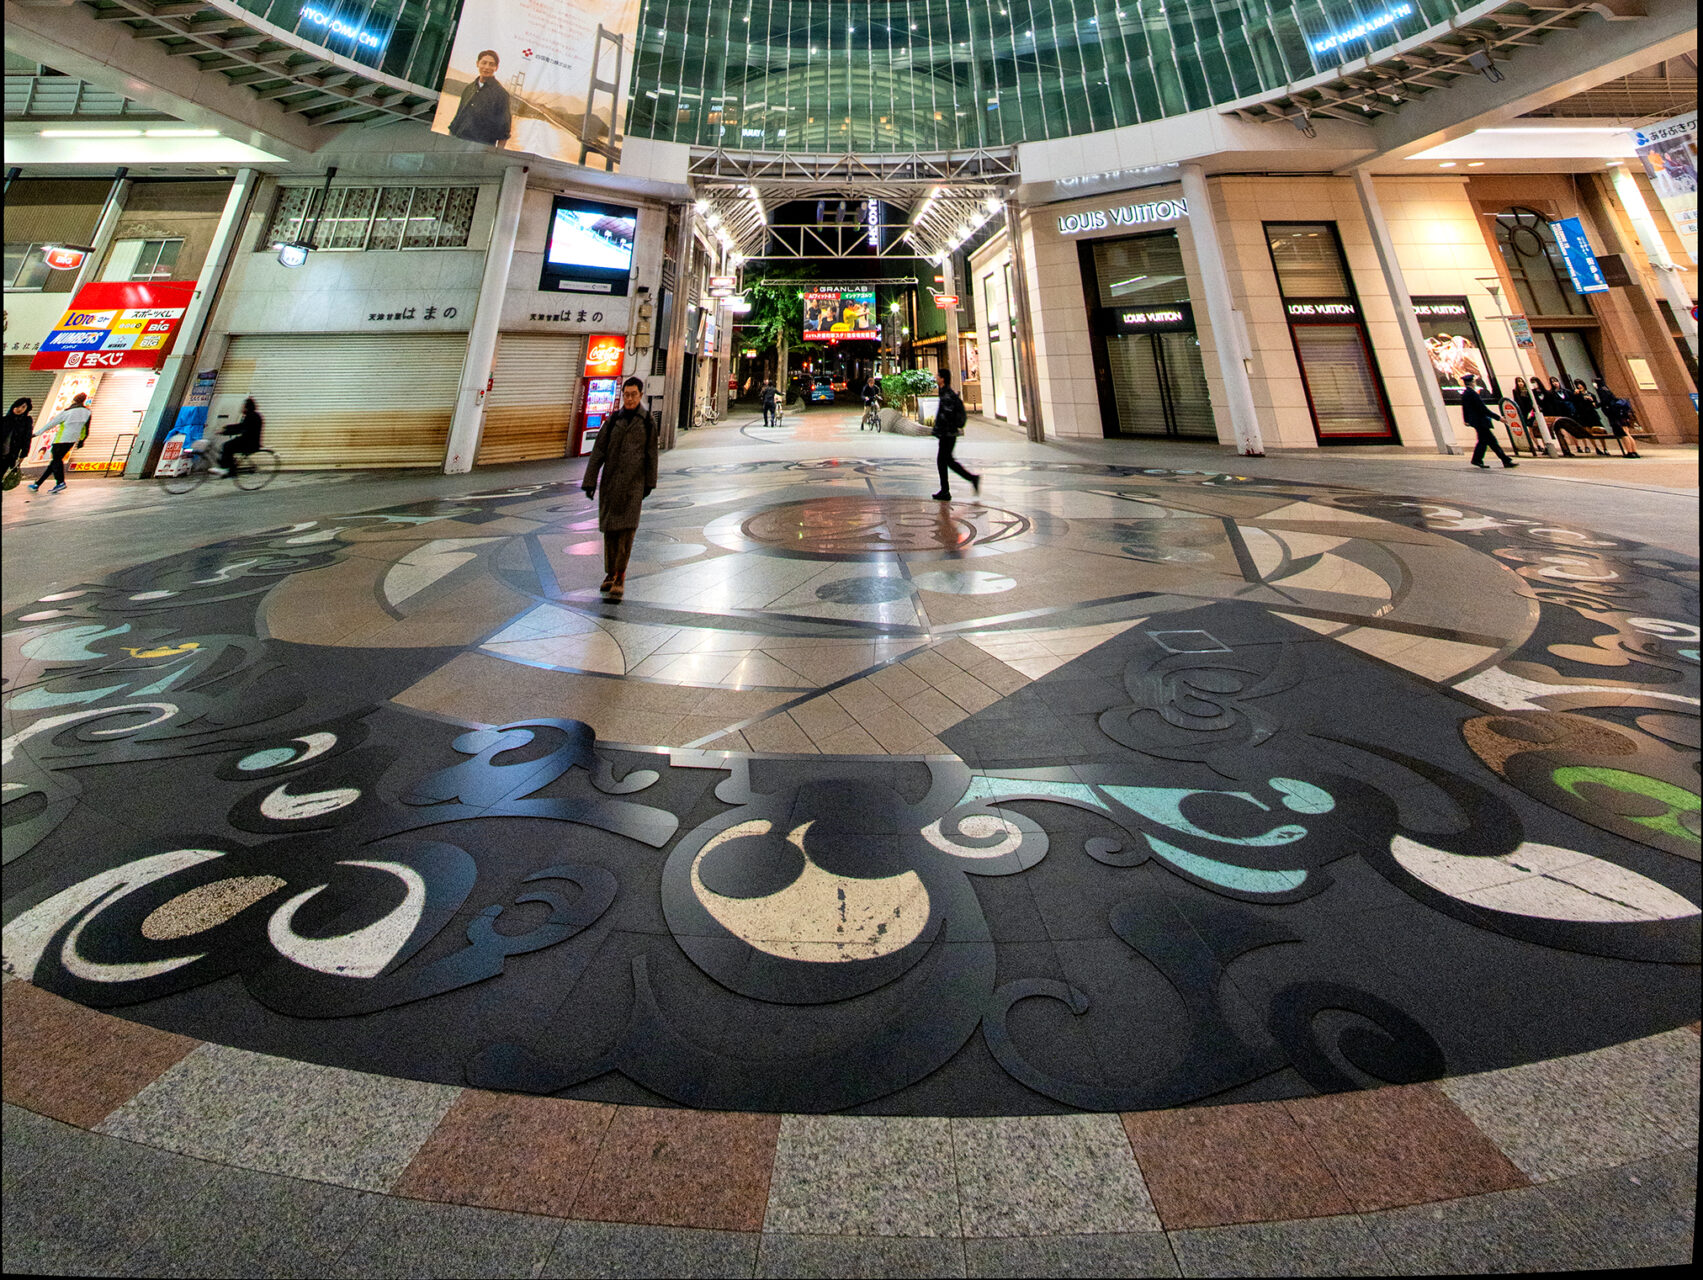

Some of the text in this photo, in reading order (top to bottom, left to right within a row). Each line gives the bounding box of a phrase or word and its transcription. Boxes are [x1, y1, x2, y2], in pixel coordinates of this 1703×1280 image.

[1058, 198, 1189, 235] LOUIS VUITTON
[131, 309, 174, 319] スポーツくじ
[1288, 304, 1355, 315] LOUIS VUITTON
[1123, 311, 1182, 324] LOUIS VUITTON
[50, 332, 104, 344] NUMBERS
[83, 353, 124, 366] 宝くじ
